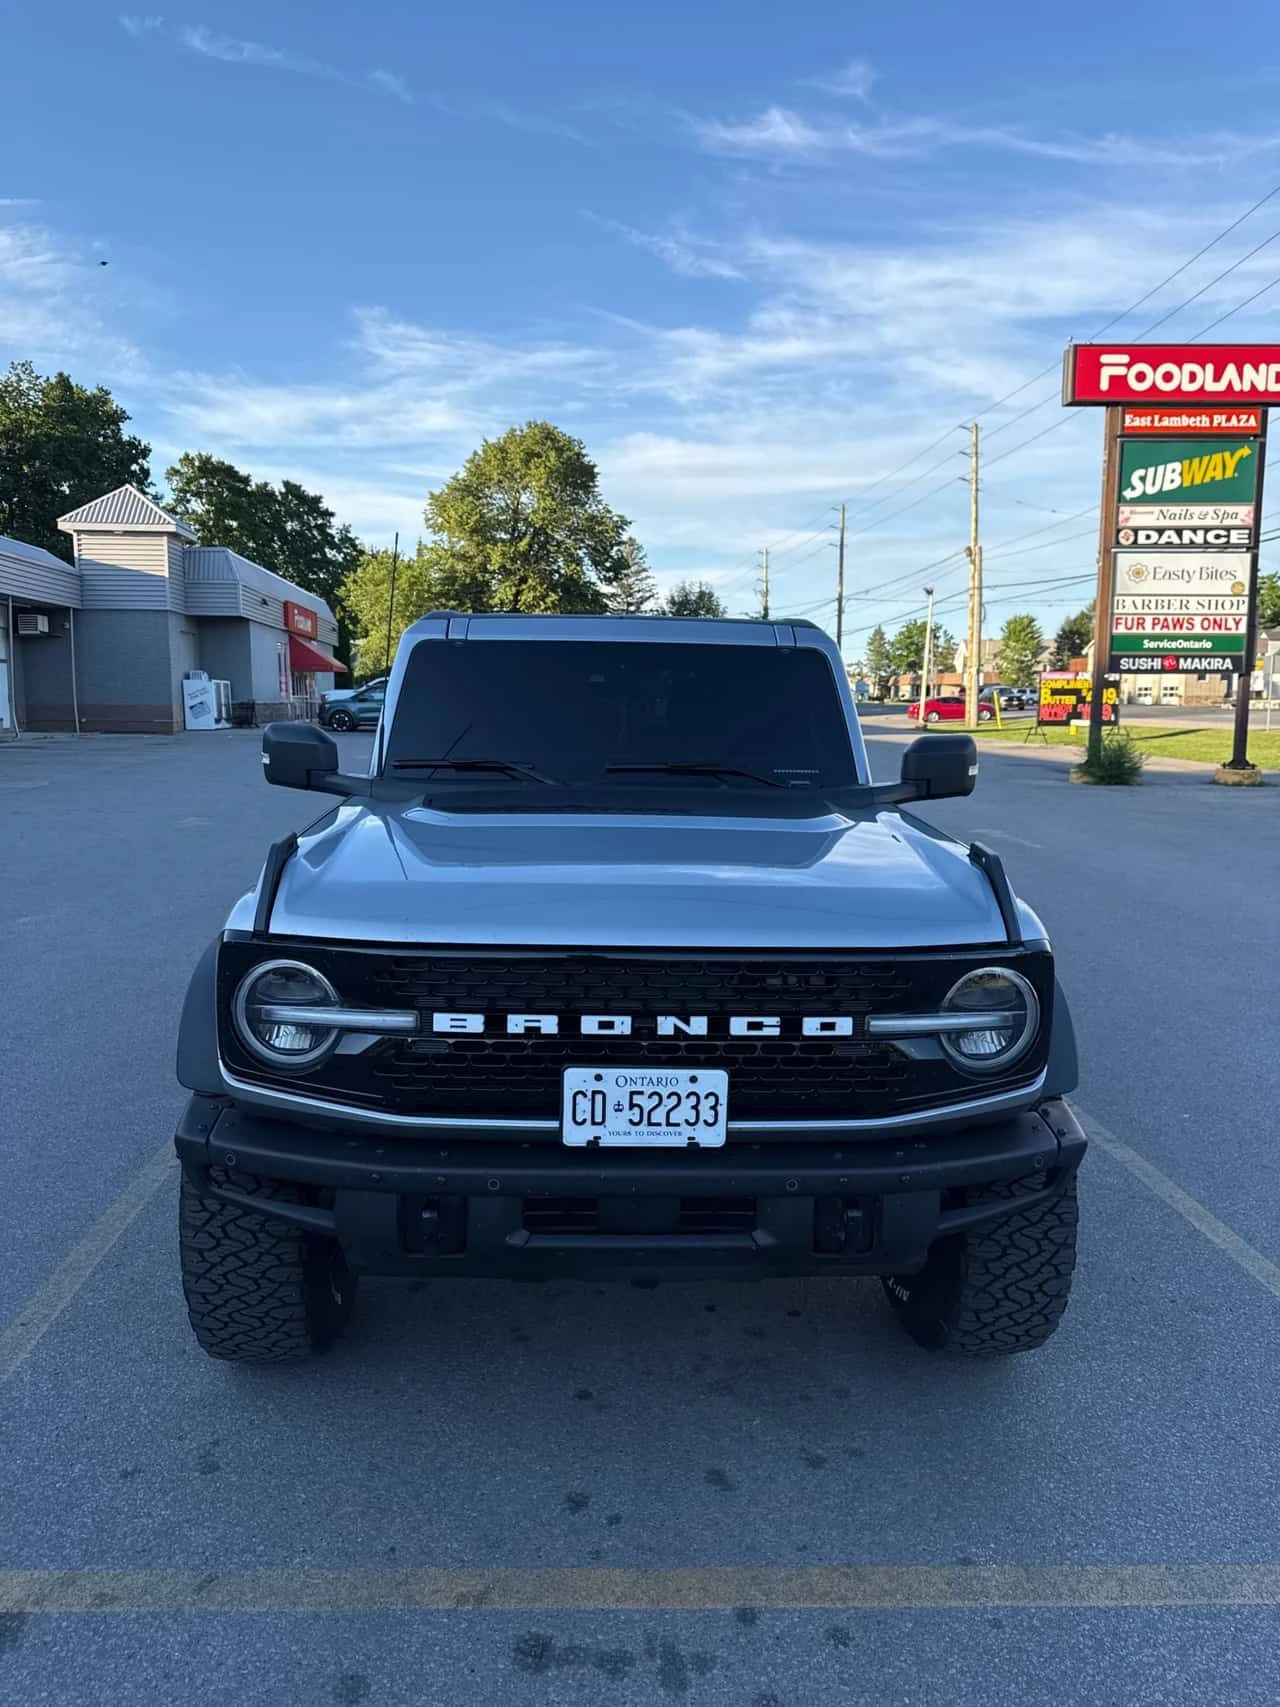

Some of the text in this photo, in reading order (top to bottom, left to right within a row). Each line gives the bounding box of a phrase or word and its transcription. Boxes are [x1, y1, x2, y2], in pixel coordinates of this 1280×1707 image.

[1124, 414, 1257, 428] East Lambeth PLAZA
[1122, 445, 1252, 501] SUBWAY
[1155, 508, 1194, 521] Nails
[1211, 508, 1239, 524] Spa
[1137, 529, 1250, 545] DANCE
[1199, 566, 1238, 581] Bites
[1115, 598, 1246, 611] BARBER SHOP
[1114, 616, 1243, 631] FUR PAWS ONLY
[1143, 639, 1212, 649] ServiceOntario
[1119, 657, 1161, 670] SUSHI
[1178, 657, 1233, 670] MAKIRA
[432, 1011, 855, 1037] BRONCO
[615, 1075, 679, 1087] ONTARIO
[572, 1090, 720, 1127] CD 52233
